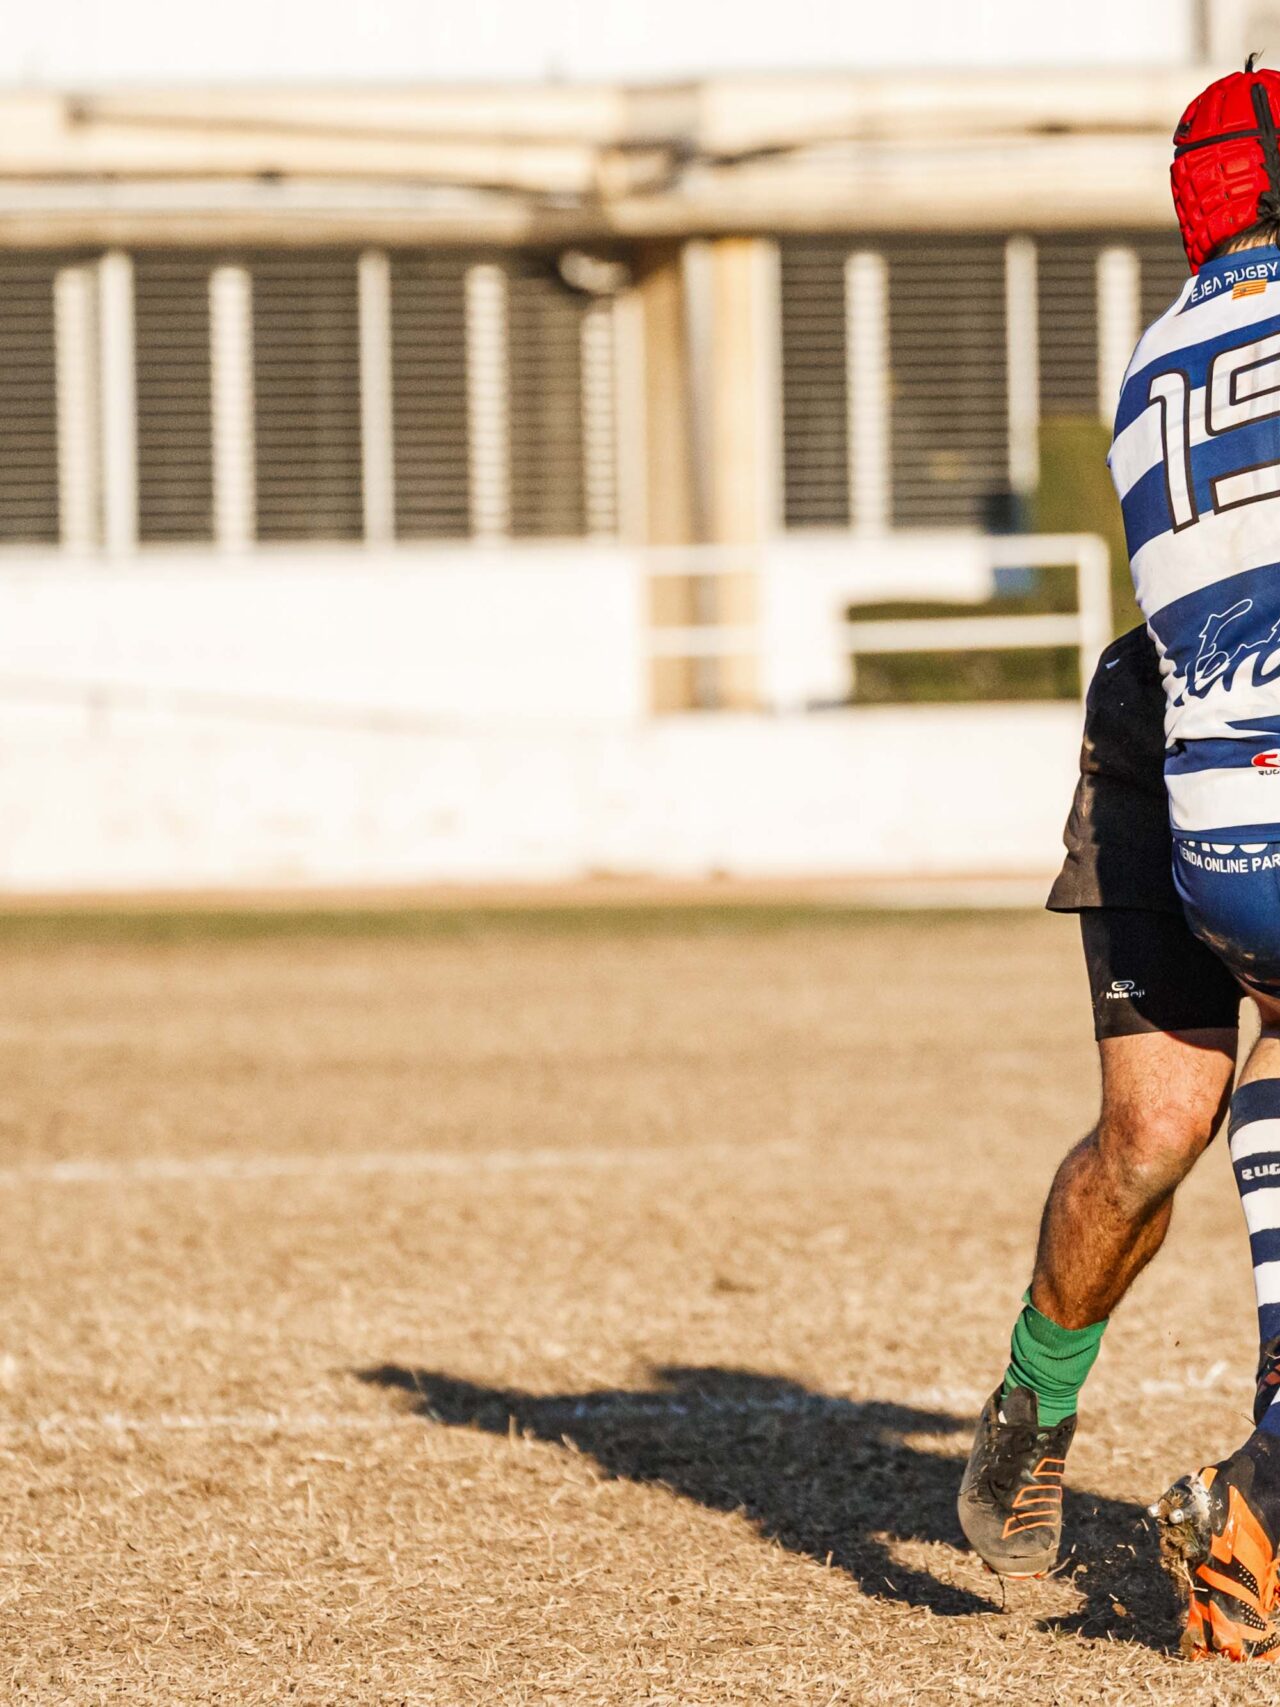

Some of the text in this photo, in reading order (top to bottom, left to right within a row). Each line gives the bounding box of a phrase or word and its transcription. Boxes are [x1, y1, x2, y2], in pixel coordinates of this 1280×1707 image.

[1191, 279, 1222, 303] EJEA
[1224, 261, 1278, 286] RUGBY
[1204, 857, 1249, 874] ONLINE
